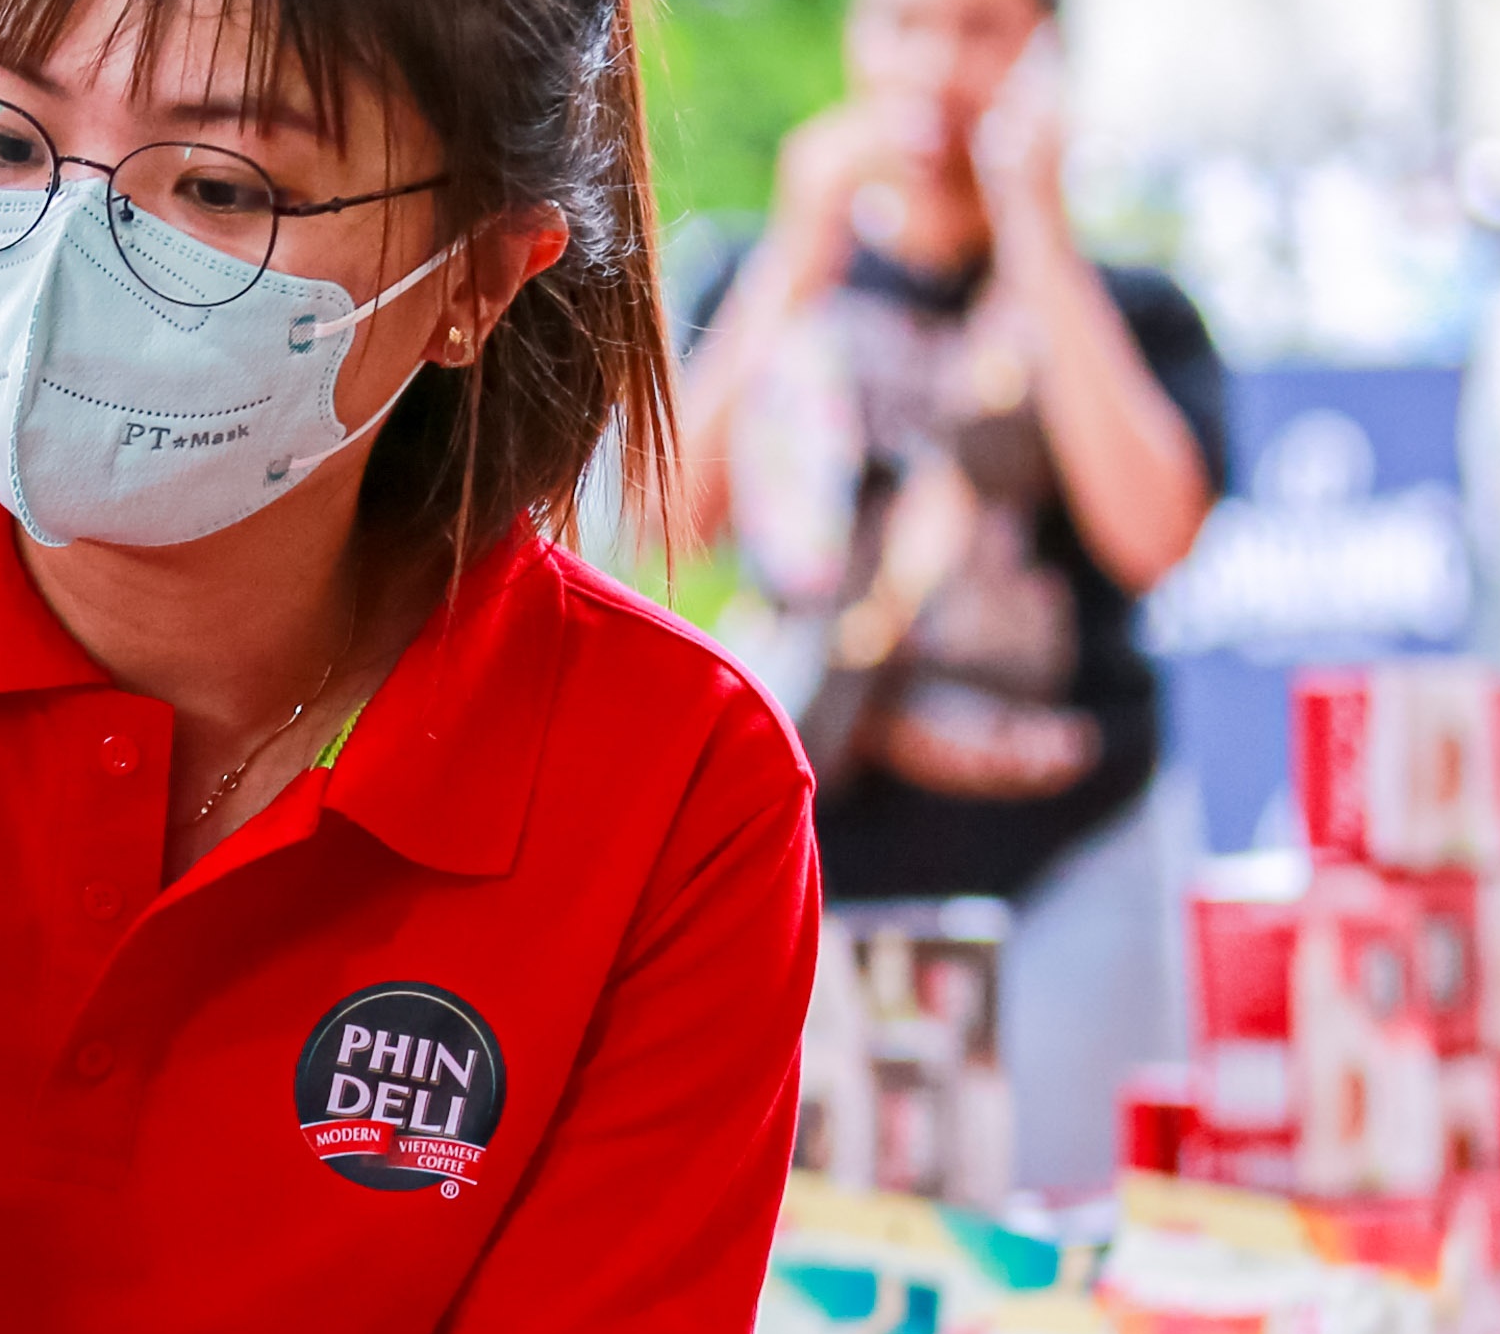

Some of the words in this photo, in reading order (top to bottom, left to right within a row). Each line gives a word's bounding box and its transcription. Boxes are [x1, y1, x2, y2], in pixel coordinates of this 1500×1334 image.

[120, 422, 171, 450] PT
[190, 424, 250, 449] Mask
[336, 1023, 478, 1092] PHIN
[325, 1072, 467, 1138] DELI
[315, 1127, 381, 1147] MODERN
[399, 1140, 481, 1163] VIETNAMESE
[417, 1155, 466, 1174] COFFEE
